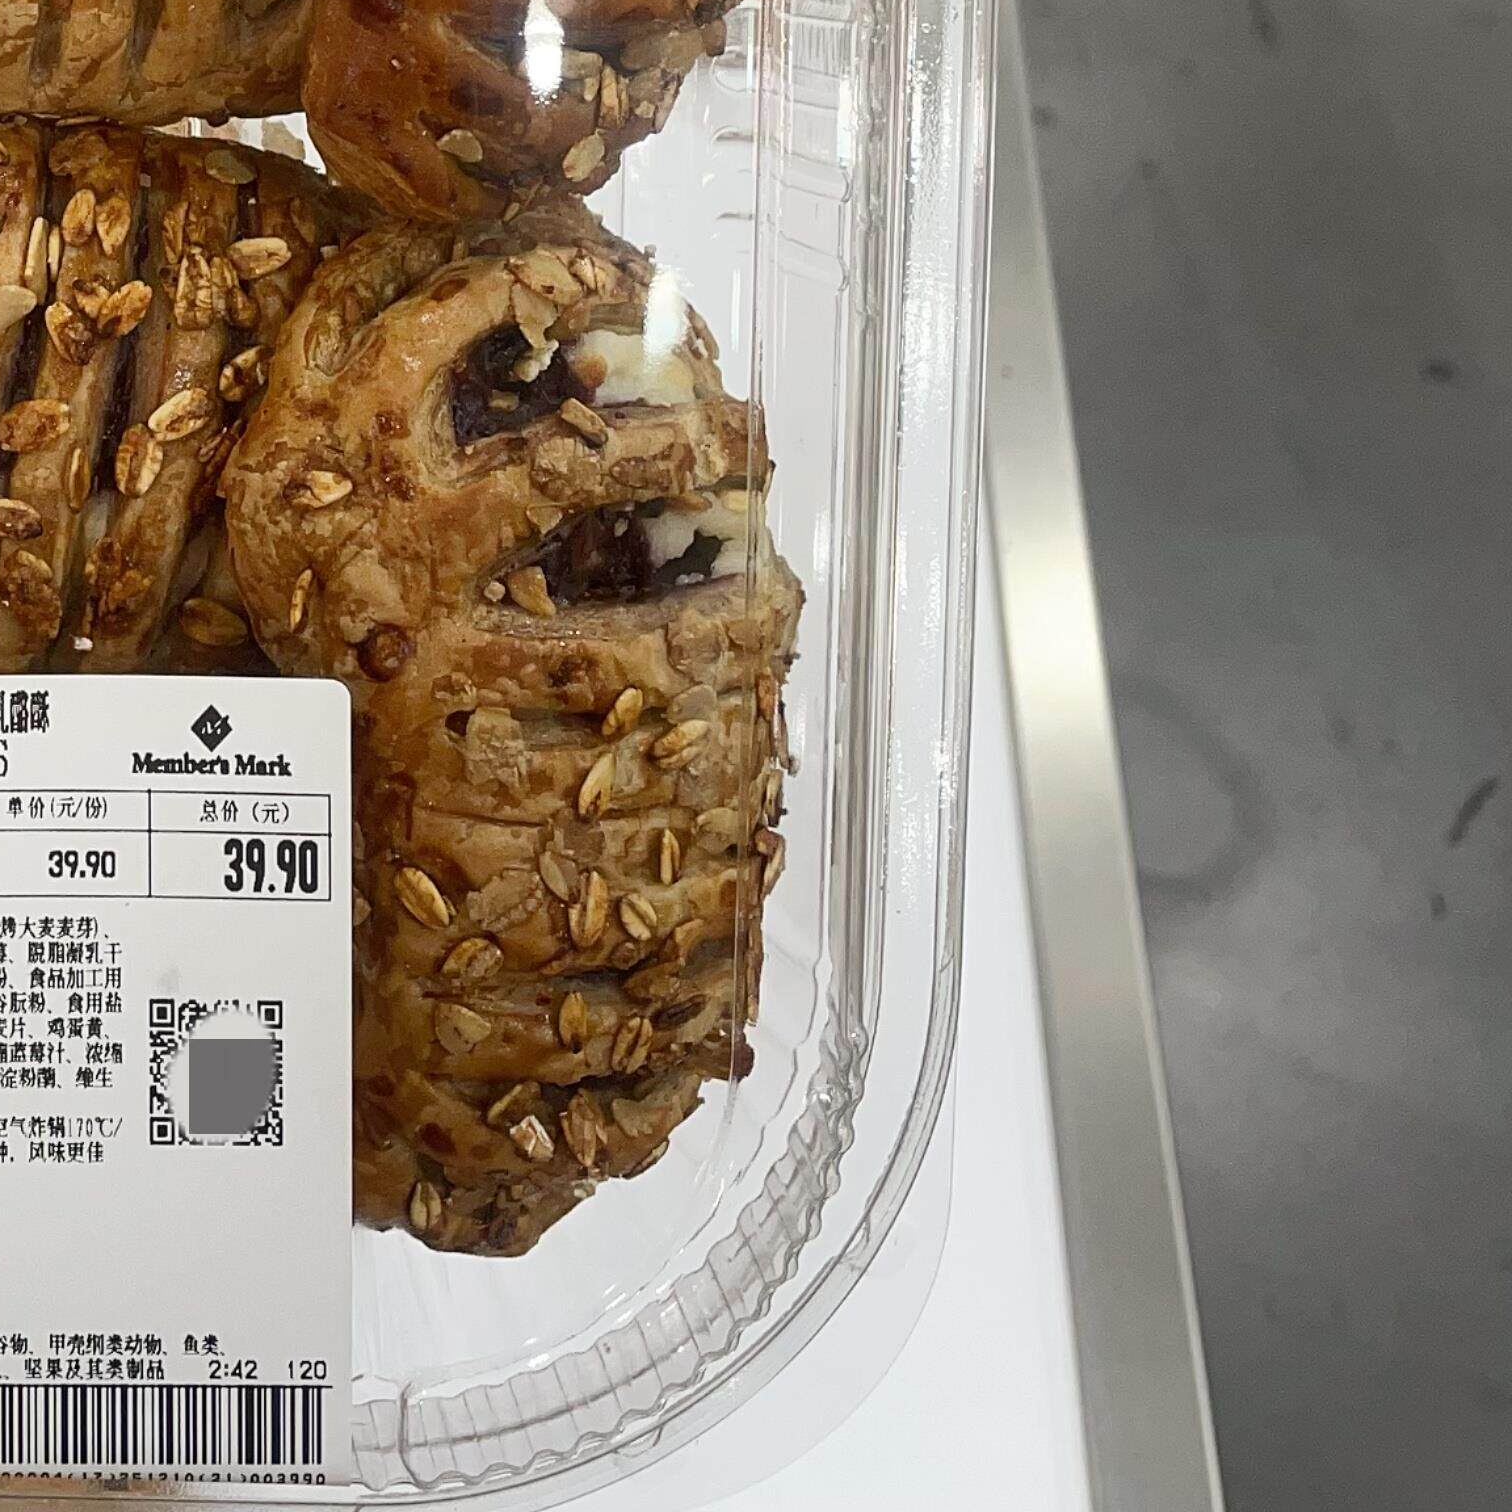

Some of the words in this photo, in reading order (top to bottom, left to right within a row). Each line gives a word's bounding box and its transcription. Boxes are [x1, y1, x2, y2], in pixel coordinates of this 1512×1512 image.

[132, 751, 230, 775] Member's
[234, 753, 293, 776] Mark
[48, 849, 116, 879] 39.90
[223, 838, 319, 894] 39.90
[208, 1360, 258, 1380] 2:42
[288, 1360, 327, 1381] 120
